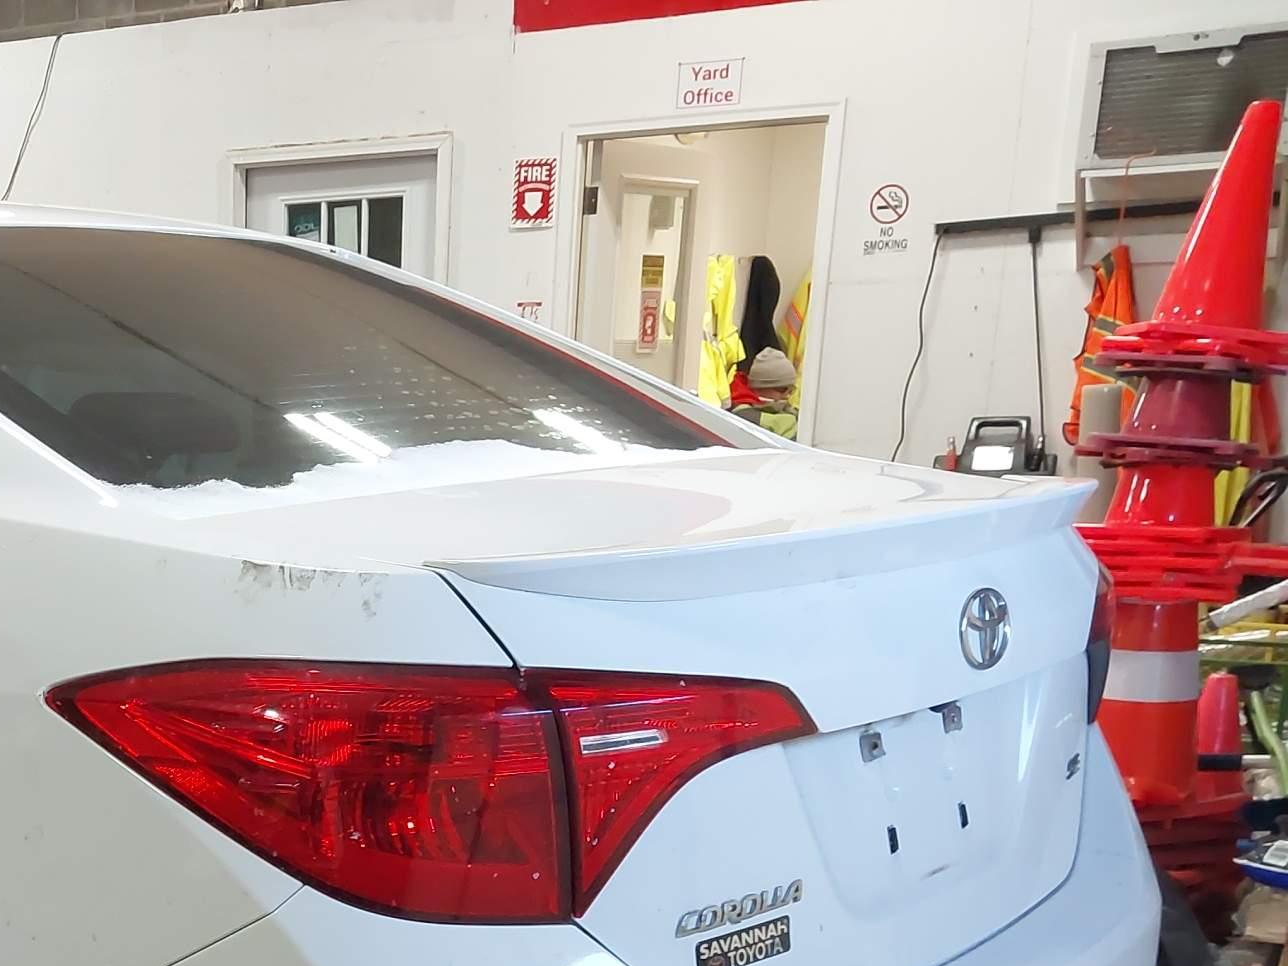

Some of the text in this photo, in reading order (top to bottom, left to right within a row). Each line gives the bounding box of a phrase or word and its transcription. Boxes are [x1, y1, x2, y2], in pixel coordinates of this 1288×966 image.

[692, 63, 730, 82] Yard
[683, 87, 734, 105] Office
[520, 165, 551, 182] FIRE
[880, 226, 895, 238] NO
[863, 238, 909, 251] SMOKING
[675, 879, 803, 939] COROLLA
[699, 919, 788, 960] SAVANNAH
